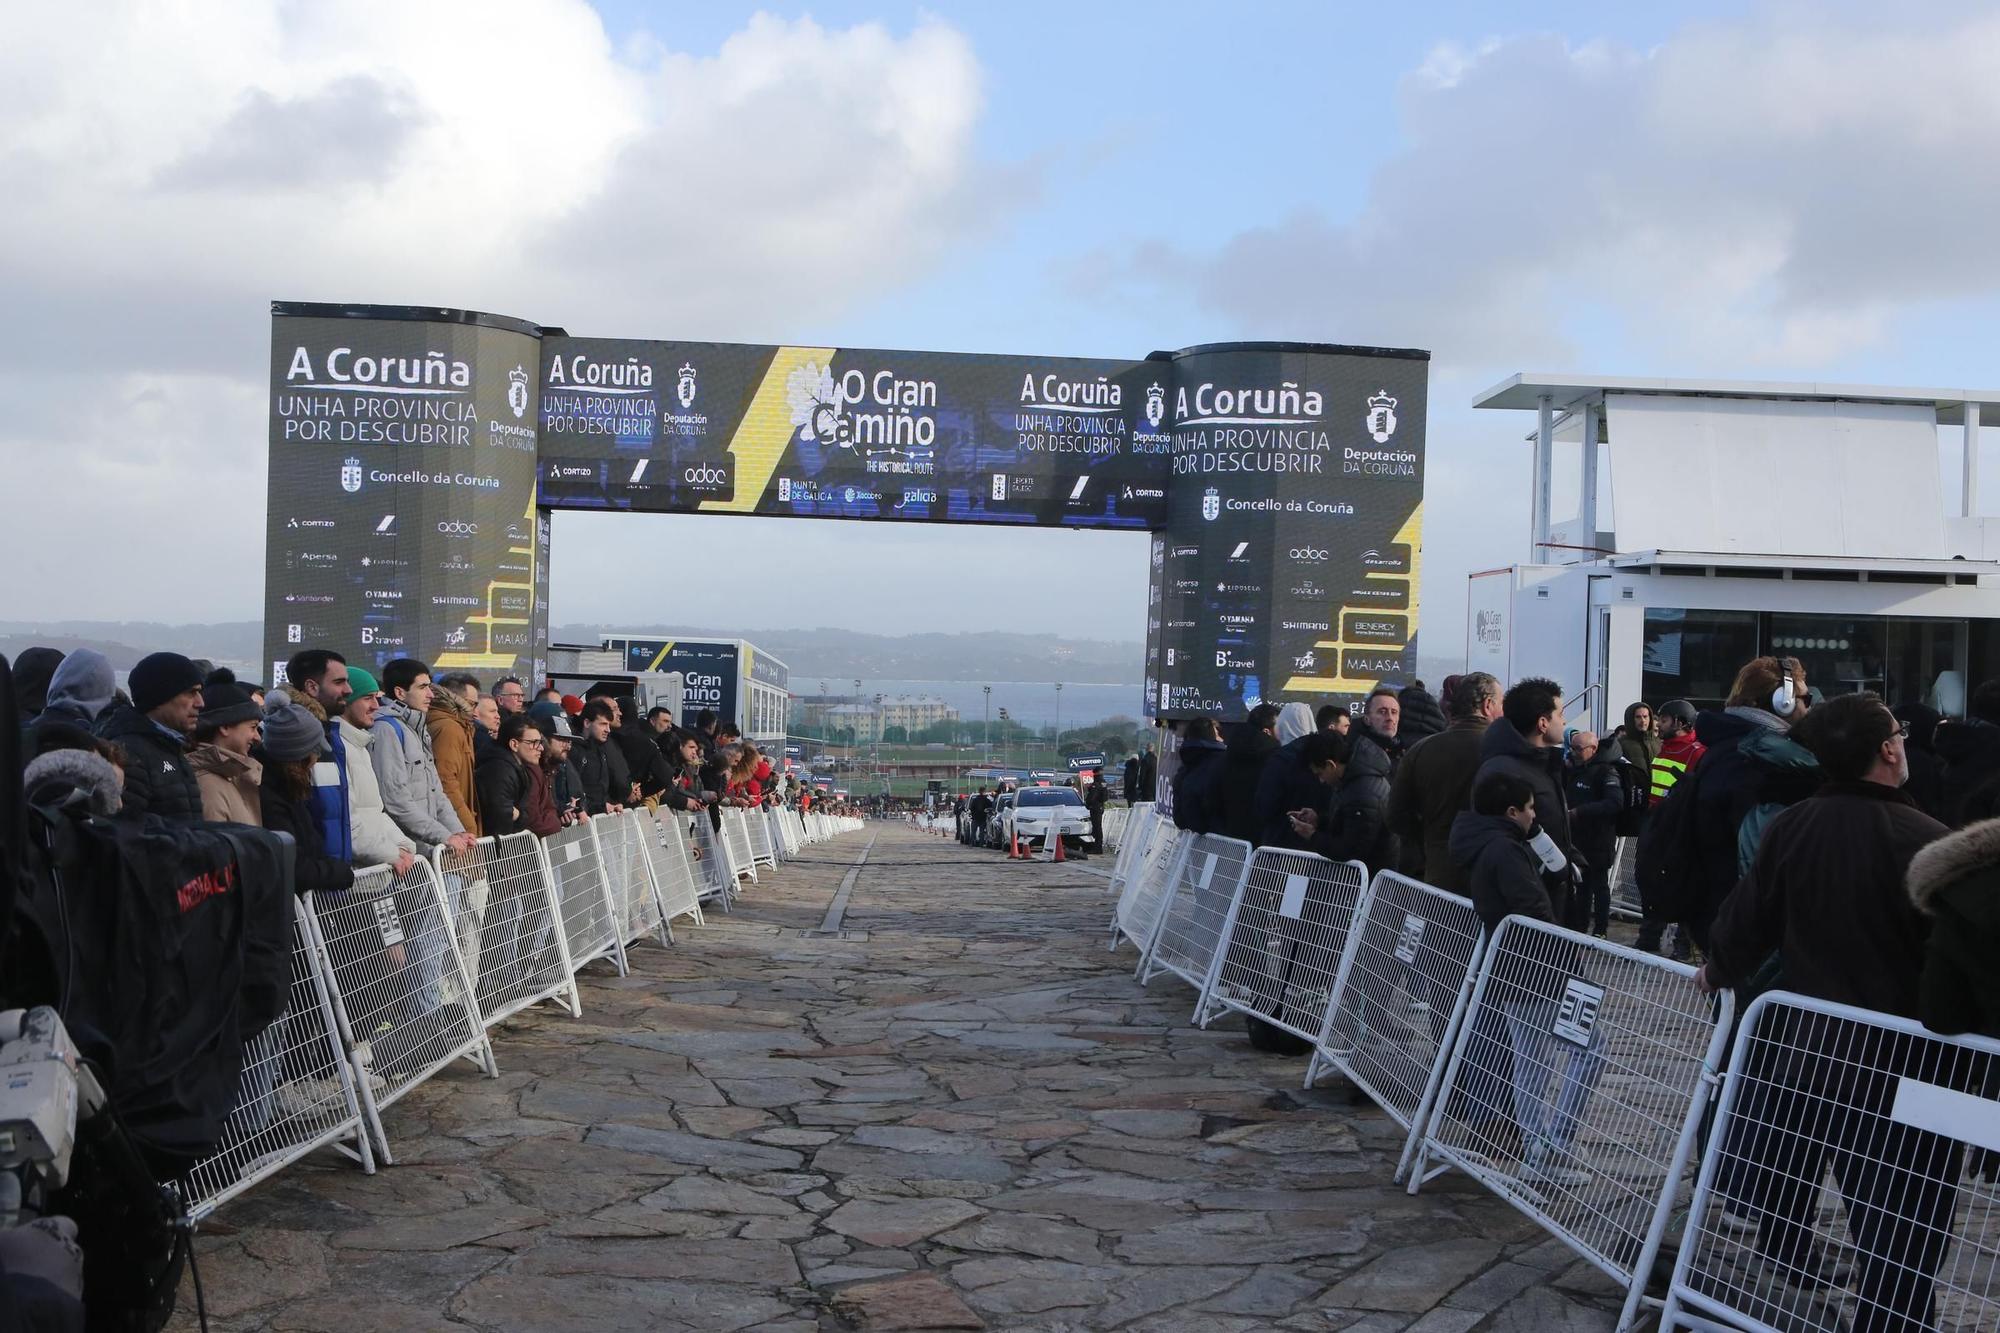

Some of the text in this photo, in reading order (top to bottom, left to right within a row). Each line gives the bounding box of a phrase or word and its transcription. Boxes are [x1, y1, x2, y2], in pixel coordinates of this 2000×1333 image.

[287, 347, 470, 387] A Coruña
[549, 354, 652, 387] A Coruña
[843, 370, 936, 407] O Gran
[1021, 374, 1121, 405] A Coruña
[544, 397, 656, 417] UNHA PROVINCIA
[1175, 382, 1322, 420] A Coruña
[279, 396, 478, 423] UNHA PROVINCIA
[548, 416, 652, 436] POR DESCUBRIR
[664, 412, 707, 426] Deputación
[812, 403, 935, 448] Camiño
[1016, 414, 1126, 436] UNHA PROVINCIA
[285, 420, 470, 446] POR DESCUBRIR
[490, 420, 535, 439] Deputación
[490, 434, 503, 447] DA
[1019, 433, 1120, 454] POR DESCUBRIR
[1133, 431, 1170, 444] Deputació
[1172, 430, 1330, 454] UNHA PROVINCIA
[1345, 448, 1416, 463] Deputación
[867, 461, 934, 475] THE HISTORICAL ROUTE
[1173, 452, 1322, 475] POR DESCUBRIR
[1344, 461, 1415, 476] DA CORUÑA
[370, 470, 500, 489] Concello da Coruña
[563, 468, 591, 476] CORTIZO
[685, 461, 726, 484] adoc
[793, 480, 817, 490] XUNTA
[792, 491, 832, 501] DE GALICIA
[895, 489, 937, 508] galicia
[1136, 489, 1163, 497] CORTIZO
[1227, 499, 1353, 514] Concello da Coruña
[438, 519, 478, 534] adoc
[1289, 545, 1328, 560] adoc
[373, 591, 403, 599] YAMAHA
[432, 596, 479, 605] SHIMANO
[1227, 615, 1255, 624] YAMAHA
[1282, 621, 1329, 630] SHIMANO
[375, 637, 404, 645] travel
[1228, 660, 1255, 668] travel
[1347, 659, 1400, 672] MALASA
[686, 671, 722, 686] Gran
[682, 685, 721, 701] miño
[1171, 686, 1201, 698] XUNTA
[1170, 698, 1224, 711] DE GALICIA
